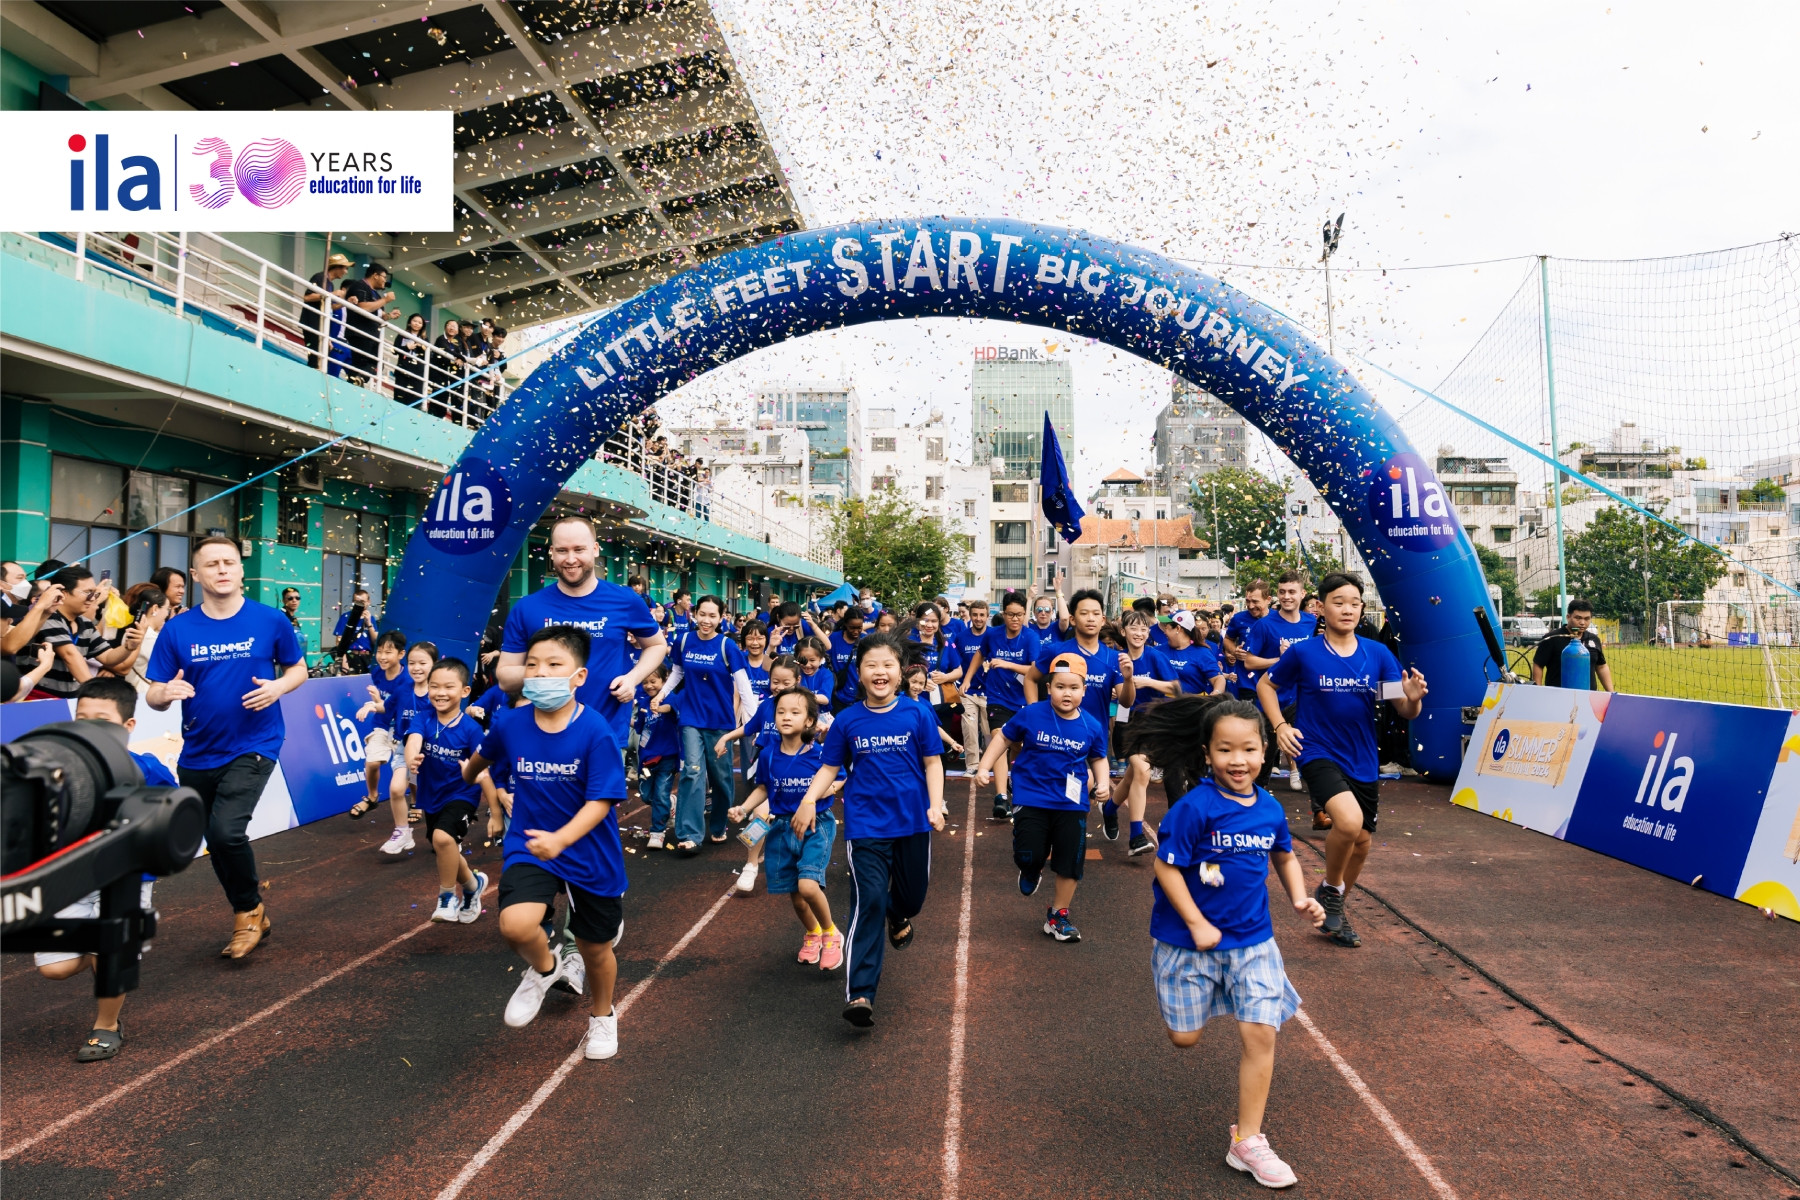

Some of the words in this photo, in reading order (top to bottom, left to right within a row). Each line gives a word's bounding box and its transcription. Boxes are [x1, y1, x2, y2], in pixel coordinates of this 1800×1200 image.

[575, 298, 702, 390] LITTLE
[712, 260, 812, 314] FEET
[832, 229, 1022, 297] START
[1037, 253, 1111, 295] BIG
[1119, 276, 1310, 394] JOURNEY
[974, 346, 1038, 360] HDBank
[435, 473, 493, 522] ila
[1389, 467, 1449, 518] ila
[429, 528, 465, 539] education
[467, 528, 479, 539] for
[481, 528, 495, 539] life
[1388, 525, 1429, 537] education
[1430, 525, 1442, 535] for
[1442, 524, 1454, 535] life
[190, 644, 208, 657] ila
[209, 640, 253, 654] SUMMER
[210, 653, 231, 661] Never
[232, 651, 251, 659] Ends
[1319, 675, 1333, 686] ila
[314, 703, 366, 765] ila
[854, 736, 869, 749] ila
[870, 735, 909, 747] SUMMER
[1037, 730, 1050, 742] ila
[1494, 735, 1506, 754] ila
[1508, 734, 1558, 763] SUMMER
[517, 757, 534, 773] ila
[534, 761, 578, 775] SUMMER
[1634, 730, 1695, 813] ila
[1622, 813, 1655, 835] education
[1653, 820, 1665, 838] for
[1663, 822, 1677, 842] life
[1211, 830, 1233, 847] ila
